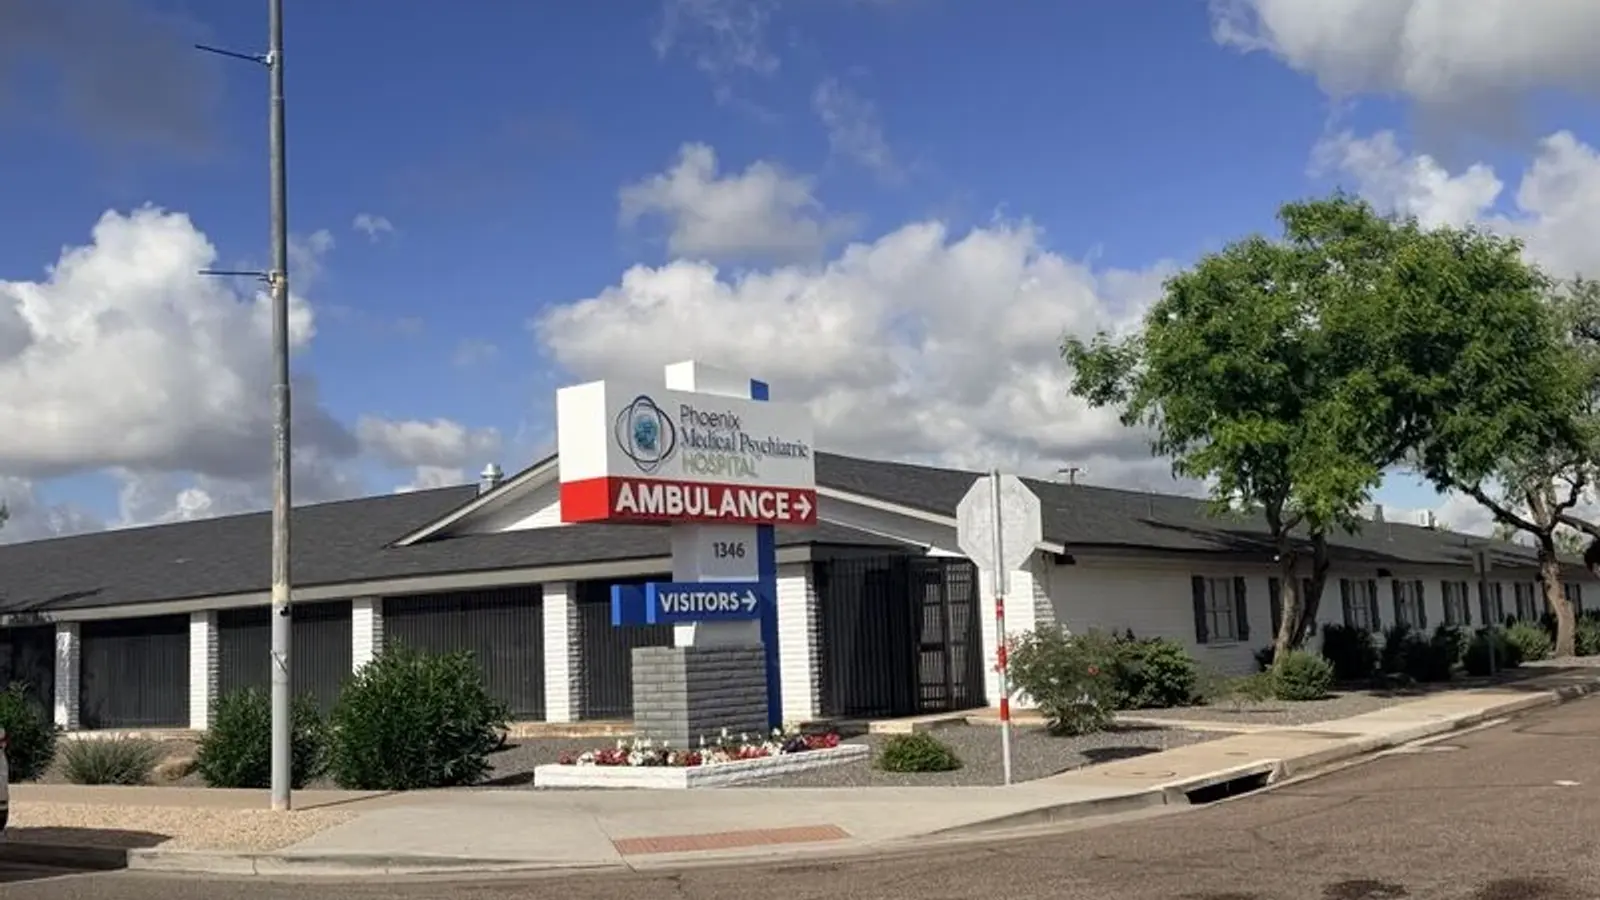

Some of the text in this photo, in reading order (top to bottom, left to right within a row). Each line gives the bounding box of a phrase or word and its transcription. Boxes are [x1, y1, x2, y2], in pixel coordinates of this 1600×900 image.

[680, 404, 740, 430] Phoenix
[680, 427, 809, 461] Medical Psychiatric
[682, 451, 759, 478] HOSPITAL
[615, 482, 790, 519] AMBULANCE
[713, 542, 745, 558] 1346
[659, 591, 740, 612] VISITORS
